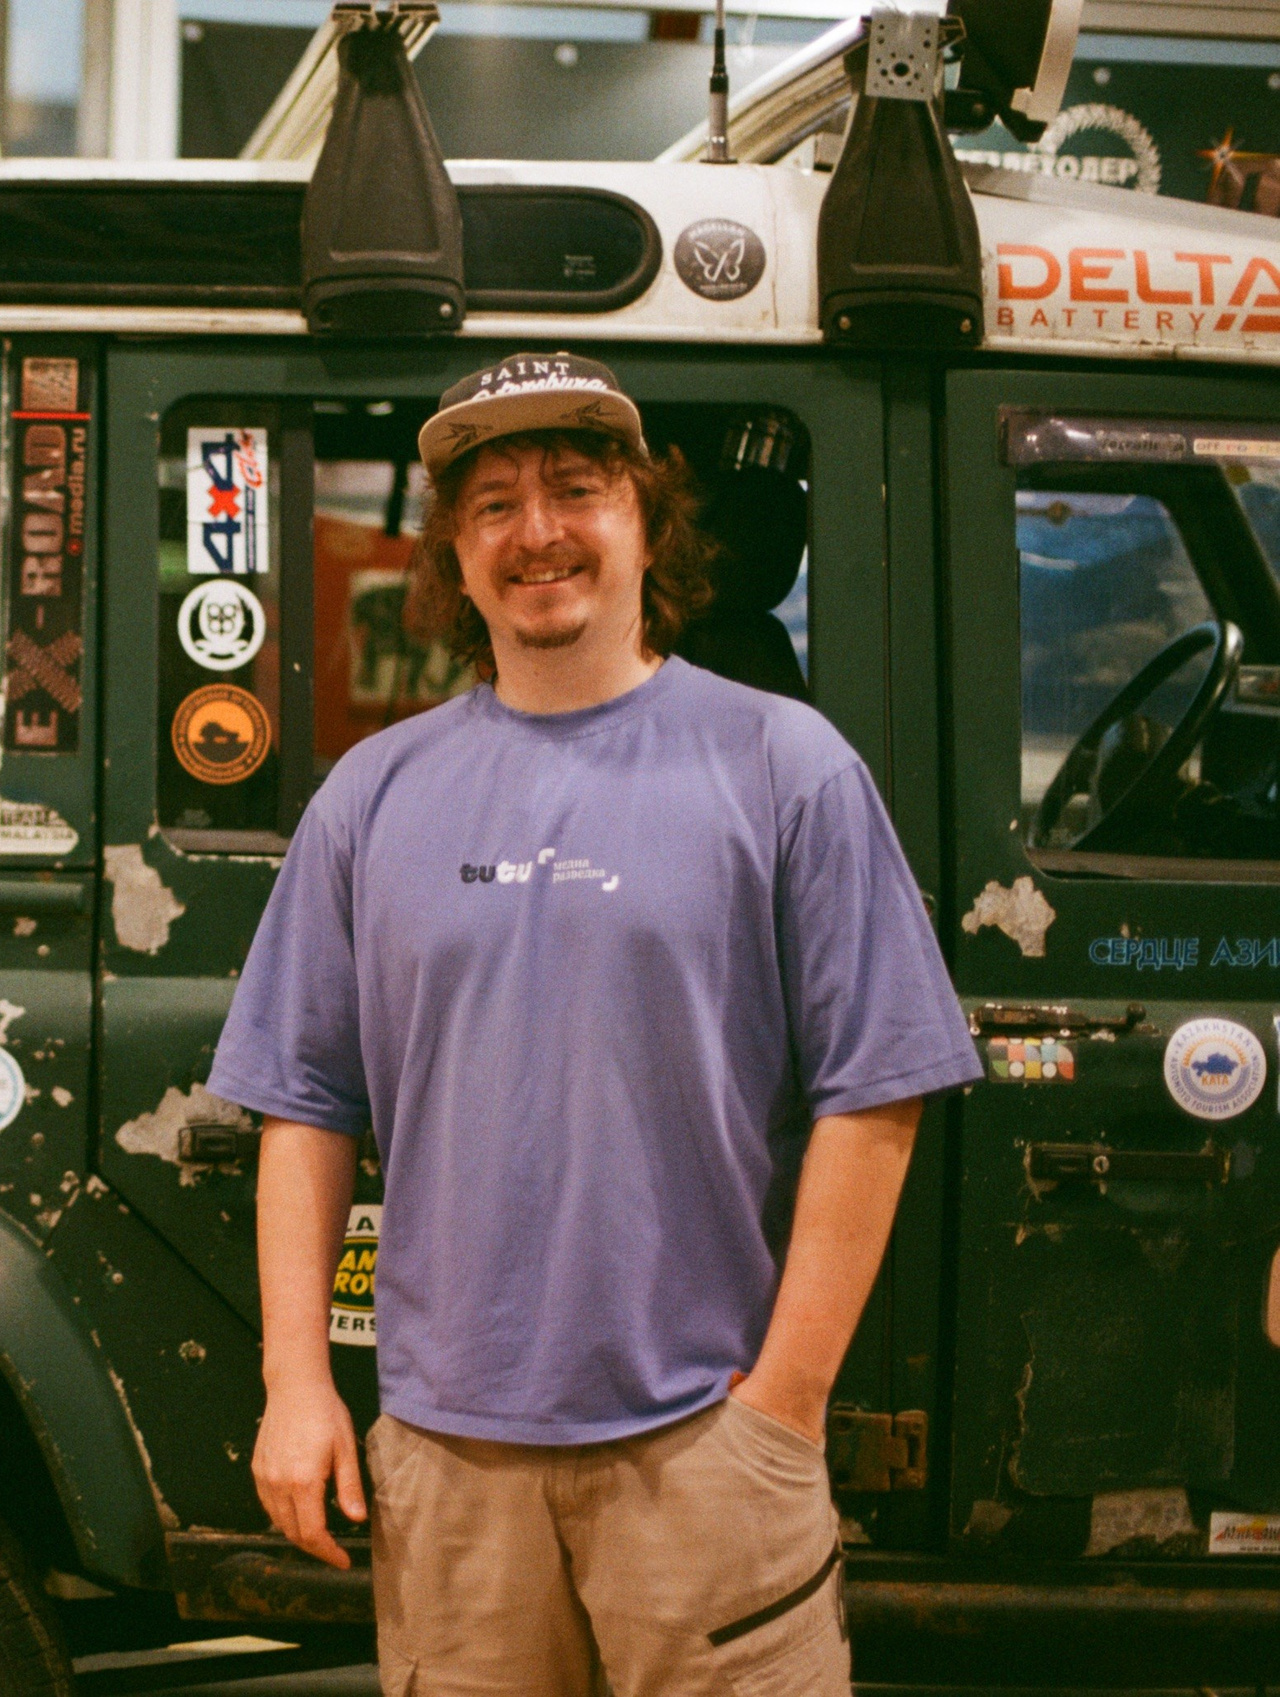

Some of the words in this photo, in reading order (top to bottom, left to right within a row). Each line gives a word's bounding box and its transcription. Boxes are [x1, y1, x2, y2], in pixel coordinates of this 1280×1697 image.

[996, 243, 1280, 307] DELTA
[996, 307, 1206, 331] BATTERY
[480, 360, 570, 386] SAINT
[67, 427, 87, 535] media.ru
[6, 424, 83, 747] EX-ROAD
[459, 860, 533, 884] tutu
[1088, 937, 1200, 970] СЕРДЦЕ
[1210, 936, 1280, 969] АЗИ
